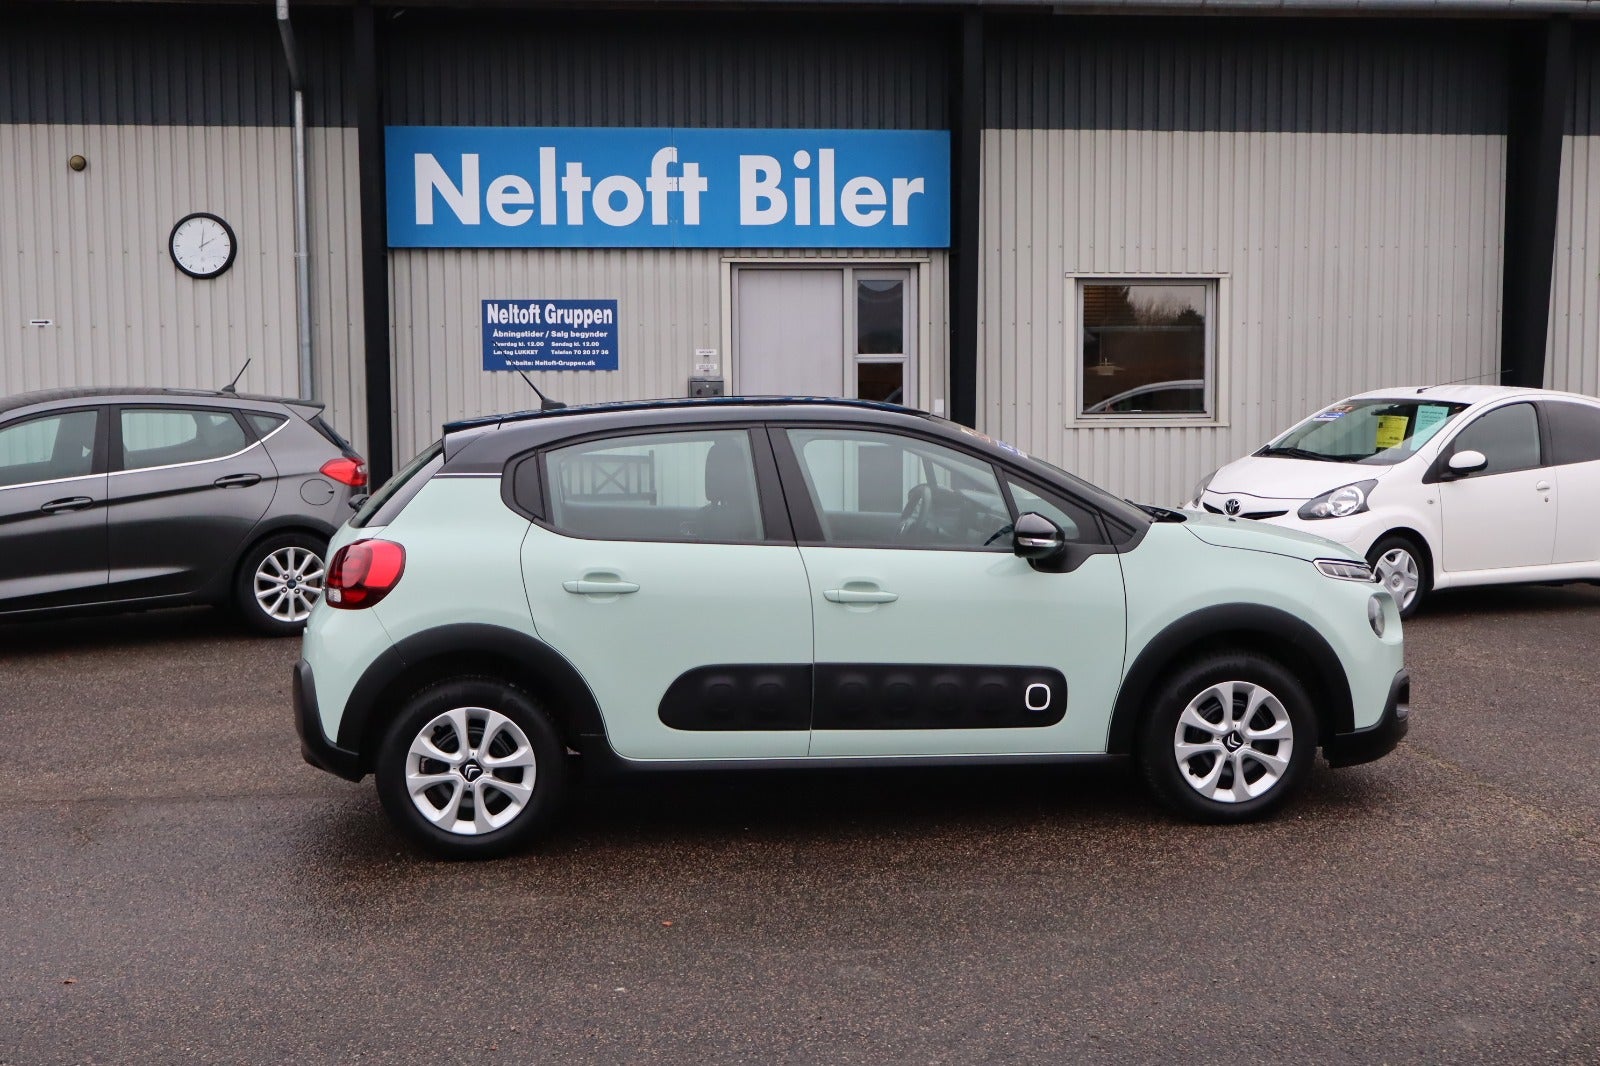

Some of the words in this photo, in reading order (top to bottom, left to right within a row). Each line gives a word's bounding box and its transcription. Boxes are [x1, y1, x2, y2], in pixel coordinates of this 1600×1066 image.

[414, 146, 708, 227] Neltoft
[739, 148, 925, 227] Biler
[487, 303, 541, 324] Neltoft
[544, 303, 613, 328] Gruppen
[492, 328, 544, 338] Åbningstider
[551, 330, 569, 338] Salg
[570, 330, 608, 338] begynder
